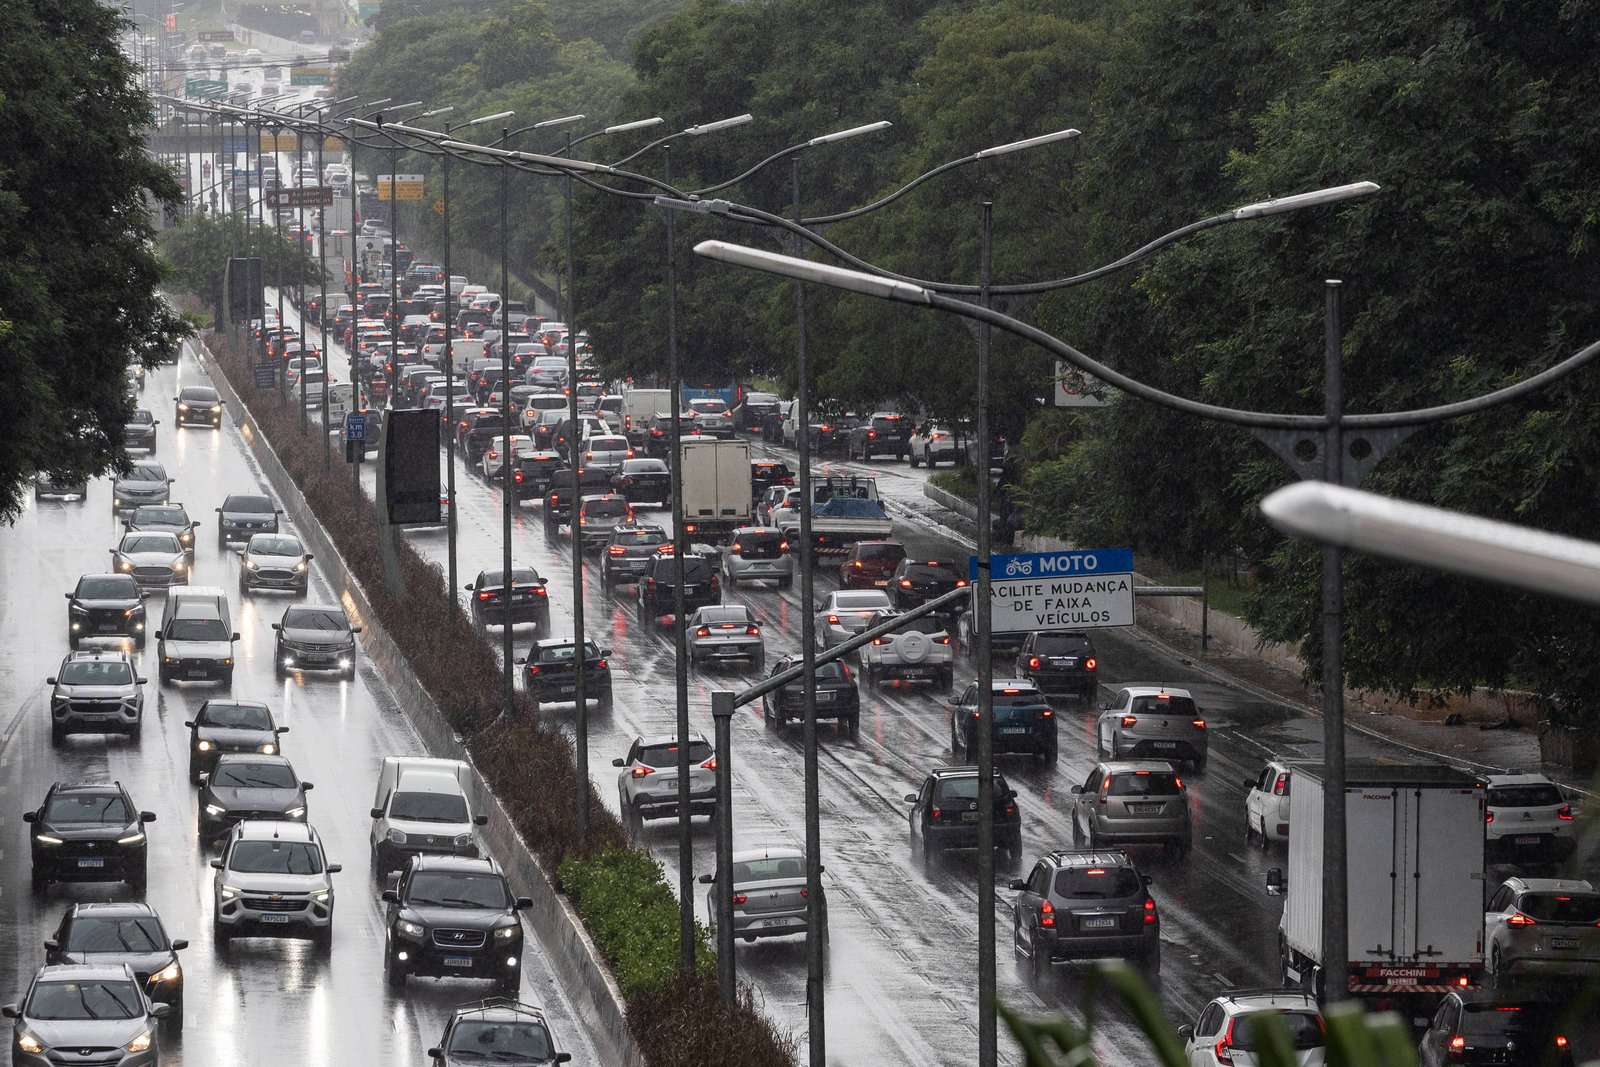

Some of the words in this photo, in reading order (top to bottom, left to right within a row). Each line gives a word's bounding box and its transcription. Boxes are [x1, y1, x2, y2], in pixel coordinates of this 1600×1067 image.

[1039, 554, 1098, 572] MOTO
[990, 584, 1044, 598] ACILITE
[1051, 580, 1129, 595] MUDANÇA
[1014, 600, 1033, 612] DE
[1045, 596, 1092, 610] FAIXA
[1036, 610, 1110, 625] VEÍCULOS
[1380, 969, 1426, 977] FACCHINI
